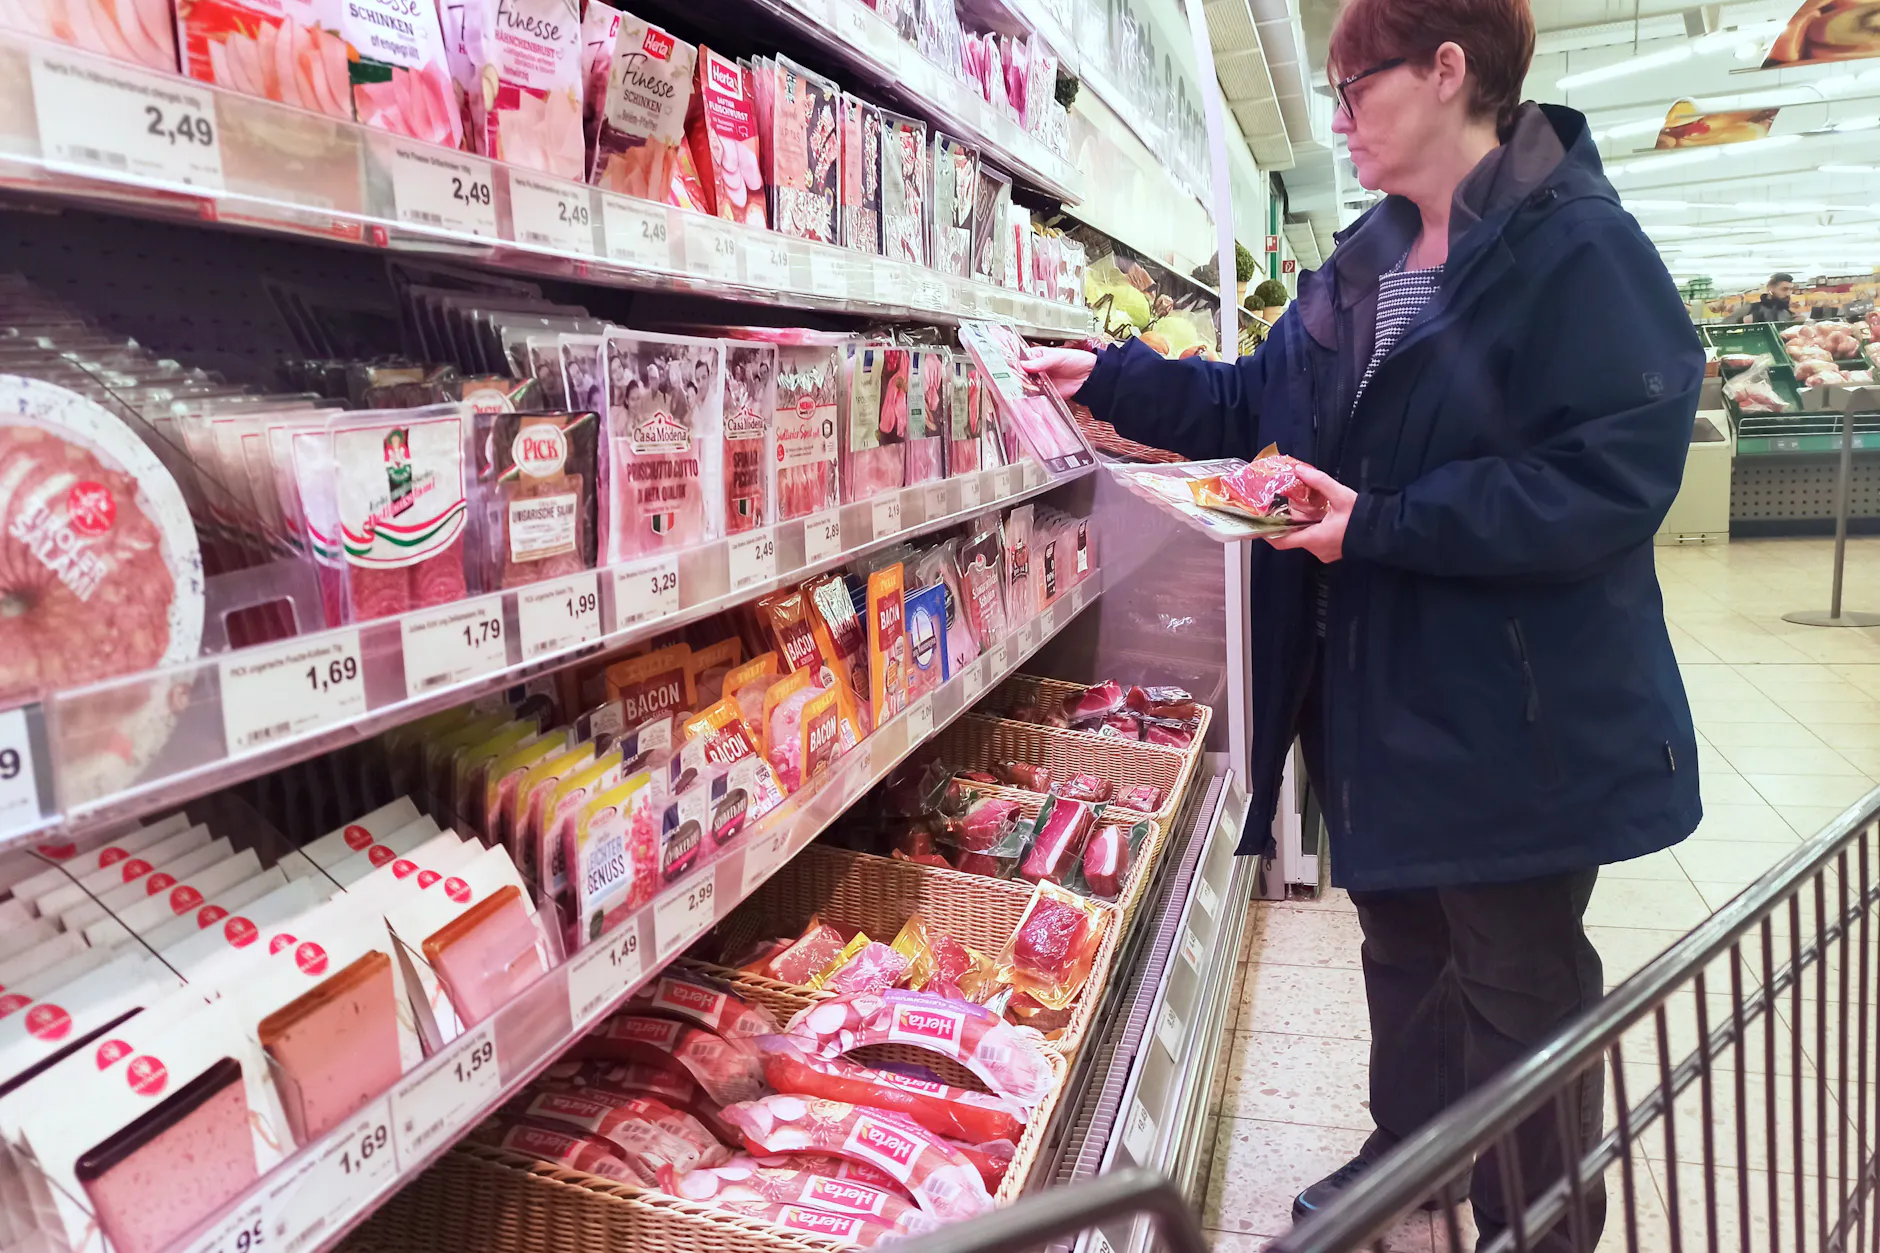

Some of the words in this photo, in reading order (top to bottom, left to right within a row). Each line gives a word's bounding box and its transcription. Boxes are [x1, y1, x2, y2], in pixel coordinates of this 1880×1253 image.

[350, 4, 414, 36] SCHINKEN
[496, 0, 563, 41] Finesse
[645, 31, 668, 56] Herta
[622, 53, 676, 98] Finesse
[712, 65, 736, 89] Herta
[624, 88, 662, 114] SCHINKEN
[709, 101, 748, 122] FLEISCHWURST
[145, 105, 213, 146] 2,49
[452, 177, 491, 206] 2,49
[558, 201, 589, 227] 2,49
[641, 220, 666, 242] 2,49
[715, 236, 734, 255] 2,19
[771, 249, 788, 267] 2,19
[633, 427, 656, 443] Casa
[656, 427, 687, 442] Modena
[727, 417, 743, 432] Casa
[522, 437, 559, 462] PICK
[627, 460, 673, 482] PROSCIUTTO
[673, 458, 699, 478] COTTO
[512, 506, 555, 524] UNGARISCHE
[825, 523, 840, 541] 2,89
[9, 514, 97, 602] SALAMI
[755, 541, 774, 562] 2,49
[651, 572, 677, 594] 3,29
[566, 593, 596, 619] 1,99
[880, 603, 900, 631] BACON
[462, 618, 500, 648] 1,79
[787, 632, 816, 661] BACON
[306, 656, 357, 693] 1,69
[625, 682, 680, 721] BACON
[811, 690, 835, 714] TULIP
[810, 715, 836, 753] BACON
[709, 732, 748, 764] BACON
[587, 854, 625, 895] GENUSS
[688, 882, 713, 912] 2,99
[609, 935, 637, 967] 1,49
[673, 986, 714, 1008] Herta
[626, 1020, 668, 1039] Herta
[909, 1014, 952, 1036] Herta
[454, 1040, 494, 1084] 1,59
[893, 1074, 937, 1093] Herta
[553, 1098, 599, 1116] Herta
[338, 1124, 388, 1175] 1,69
[524, 1131, 573, 1151] Herta
[868, 1127, 911, 1158] Herta
[824, 1182, 874, 1206] Herta
[797, 1211, 850, 1232] Herta
